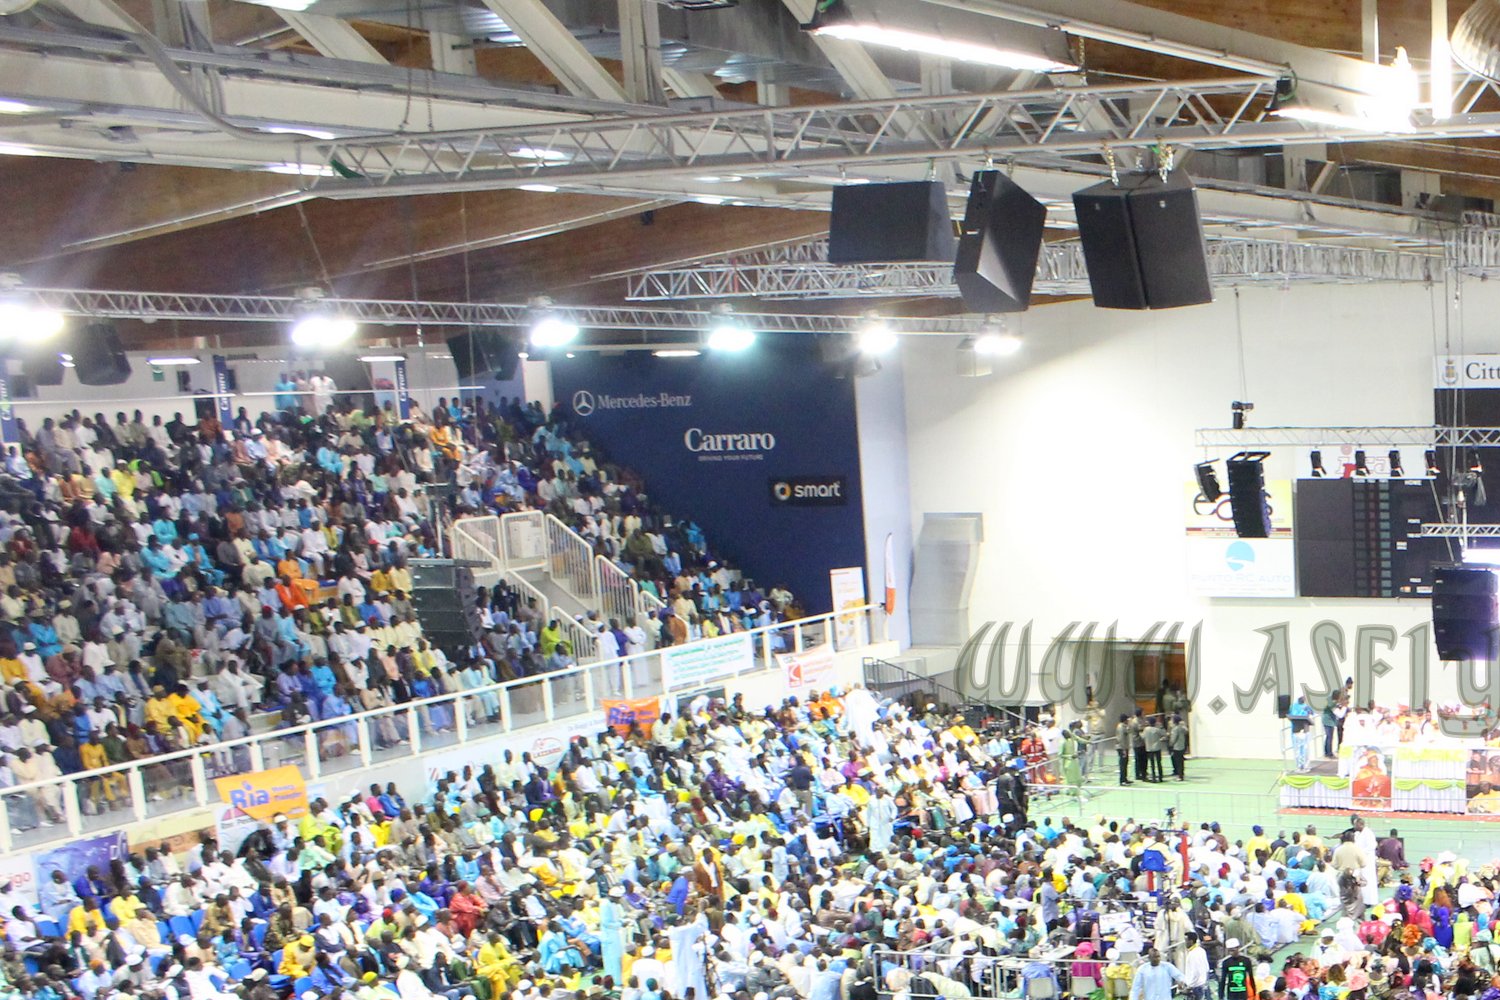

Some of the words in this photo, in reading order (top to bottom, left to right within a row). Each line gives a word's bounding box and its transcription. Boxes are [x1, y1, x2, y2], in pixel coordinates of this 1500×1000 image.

[597, 392, 693, 410] Mercedes-Benz
[684, 427, 776, 453] Carraro
[794, 481, 841, 498] smart
